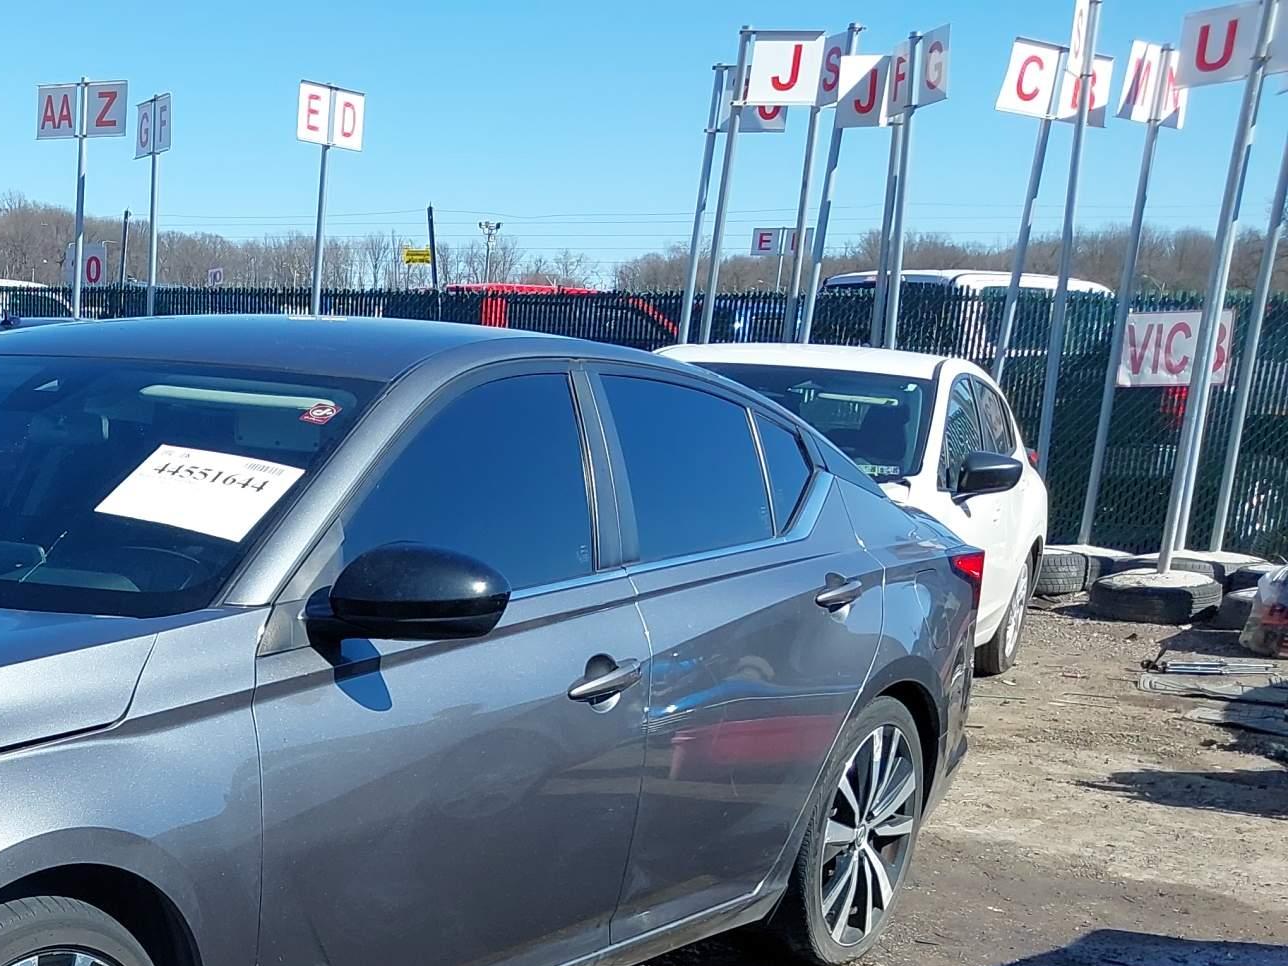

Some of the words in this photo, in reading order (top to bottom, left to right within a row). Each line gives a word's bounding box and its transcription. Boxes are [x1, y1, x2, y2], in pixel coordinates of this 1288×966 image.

[925, 40, 944, 90] G
[1195, 18, 1239, 73] U
[771, 44, 803, 91] J
[822, 46, 842, 92] S
[893, 56, 907, 103] F
[1016, 54, 1045, 102] C
[95, 90, 118, 128] Z
[853, 68, 878, 115] J
[40, 94, 73, 130] AA
[139, 111, 150, 149] G
[159, 104, 168, 143] F
[306, 94, 322, 132] E
[341, 101, 357, 138] D
[758, 232, 773, 251] E
[153, 461, 271, 493] 44551644
